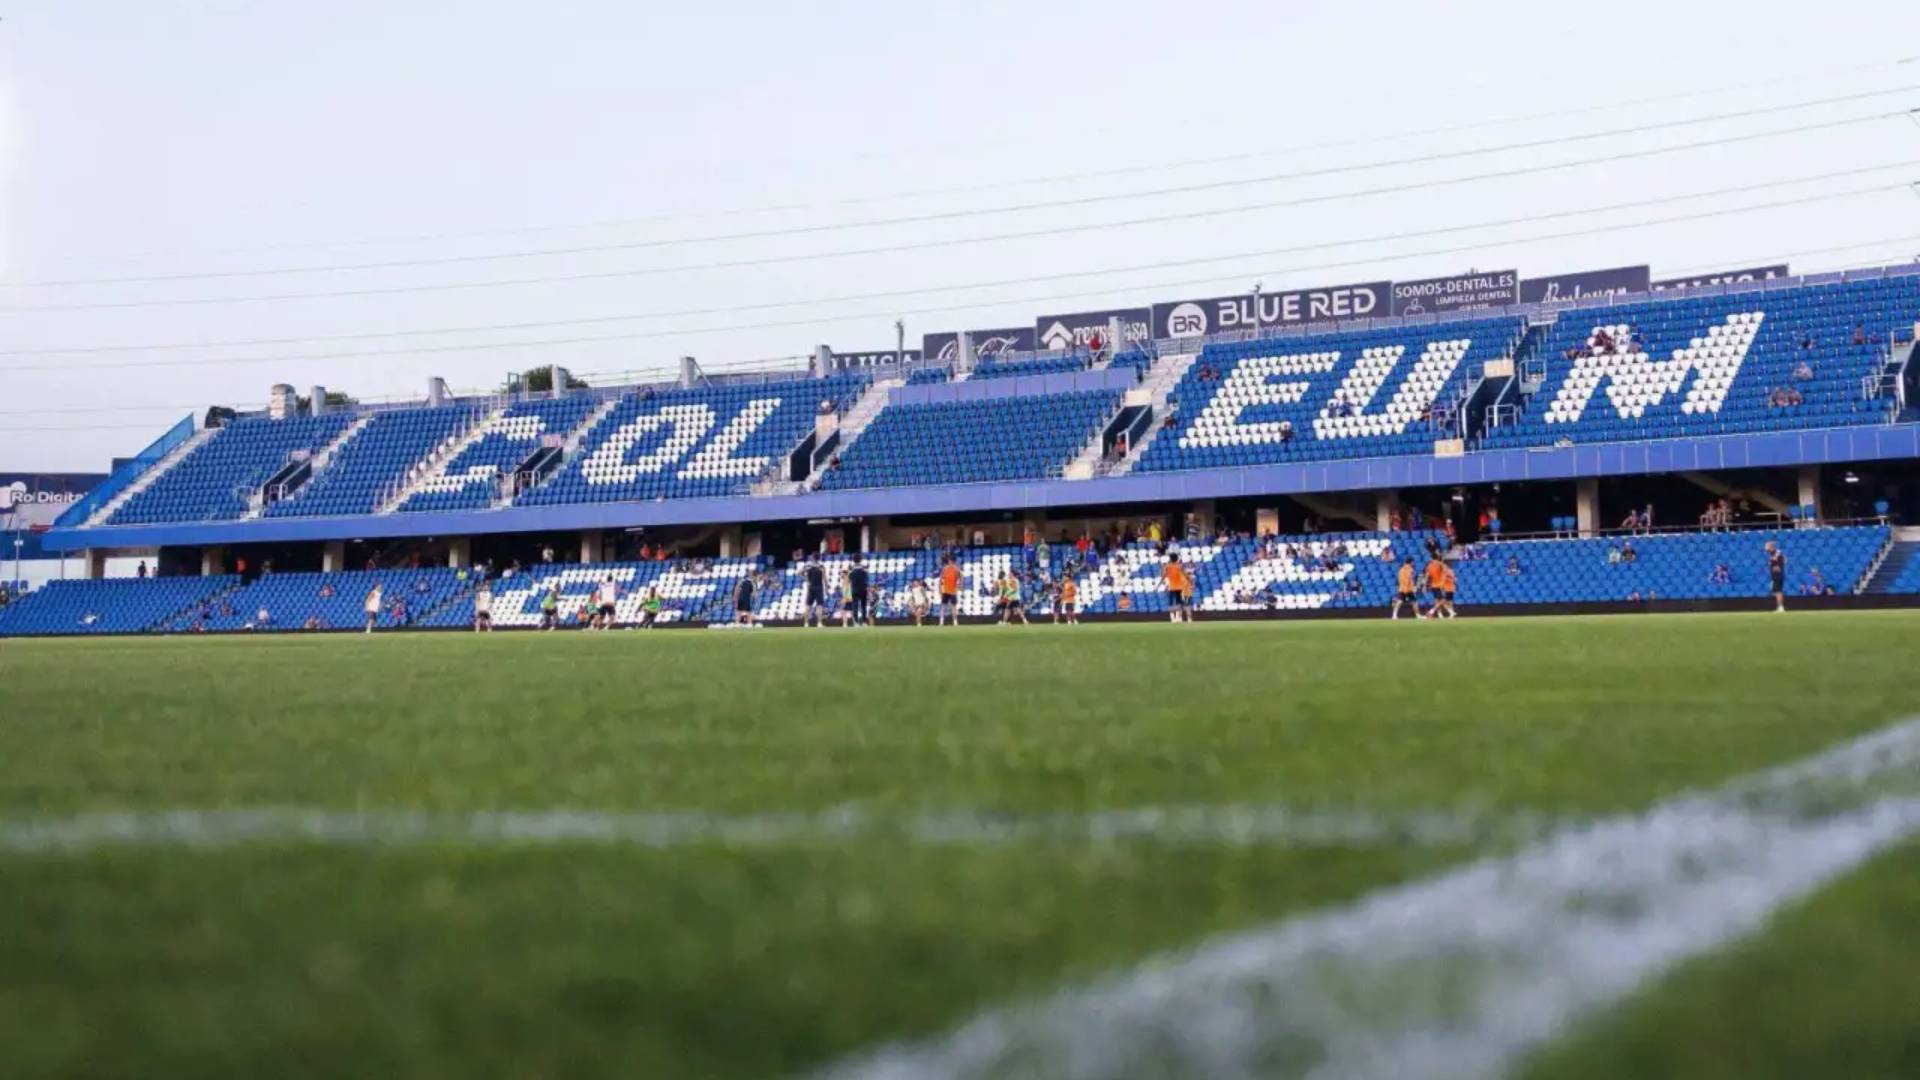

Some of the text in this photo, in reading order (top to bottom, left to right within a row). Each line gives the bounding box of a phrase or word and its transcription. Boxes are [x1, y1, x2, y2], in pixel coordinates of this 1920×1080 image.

[1395, 274, 1514, 298] SOMOS-DENTAL.ES
[1478, 290, 1512, 301] DENTAL
[1218, 287, 1377, 327] BLUE RED
[1173, 314, 1203, 333] BR
[37, 490, 89, 505] Digita
